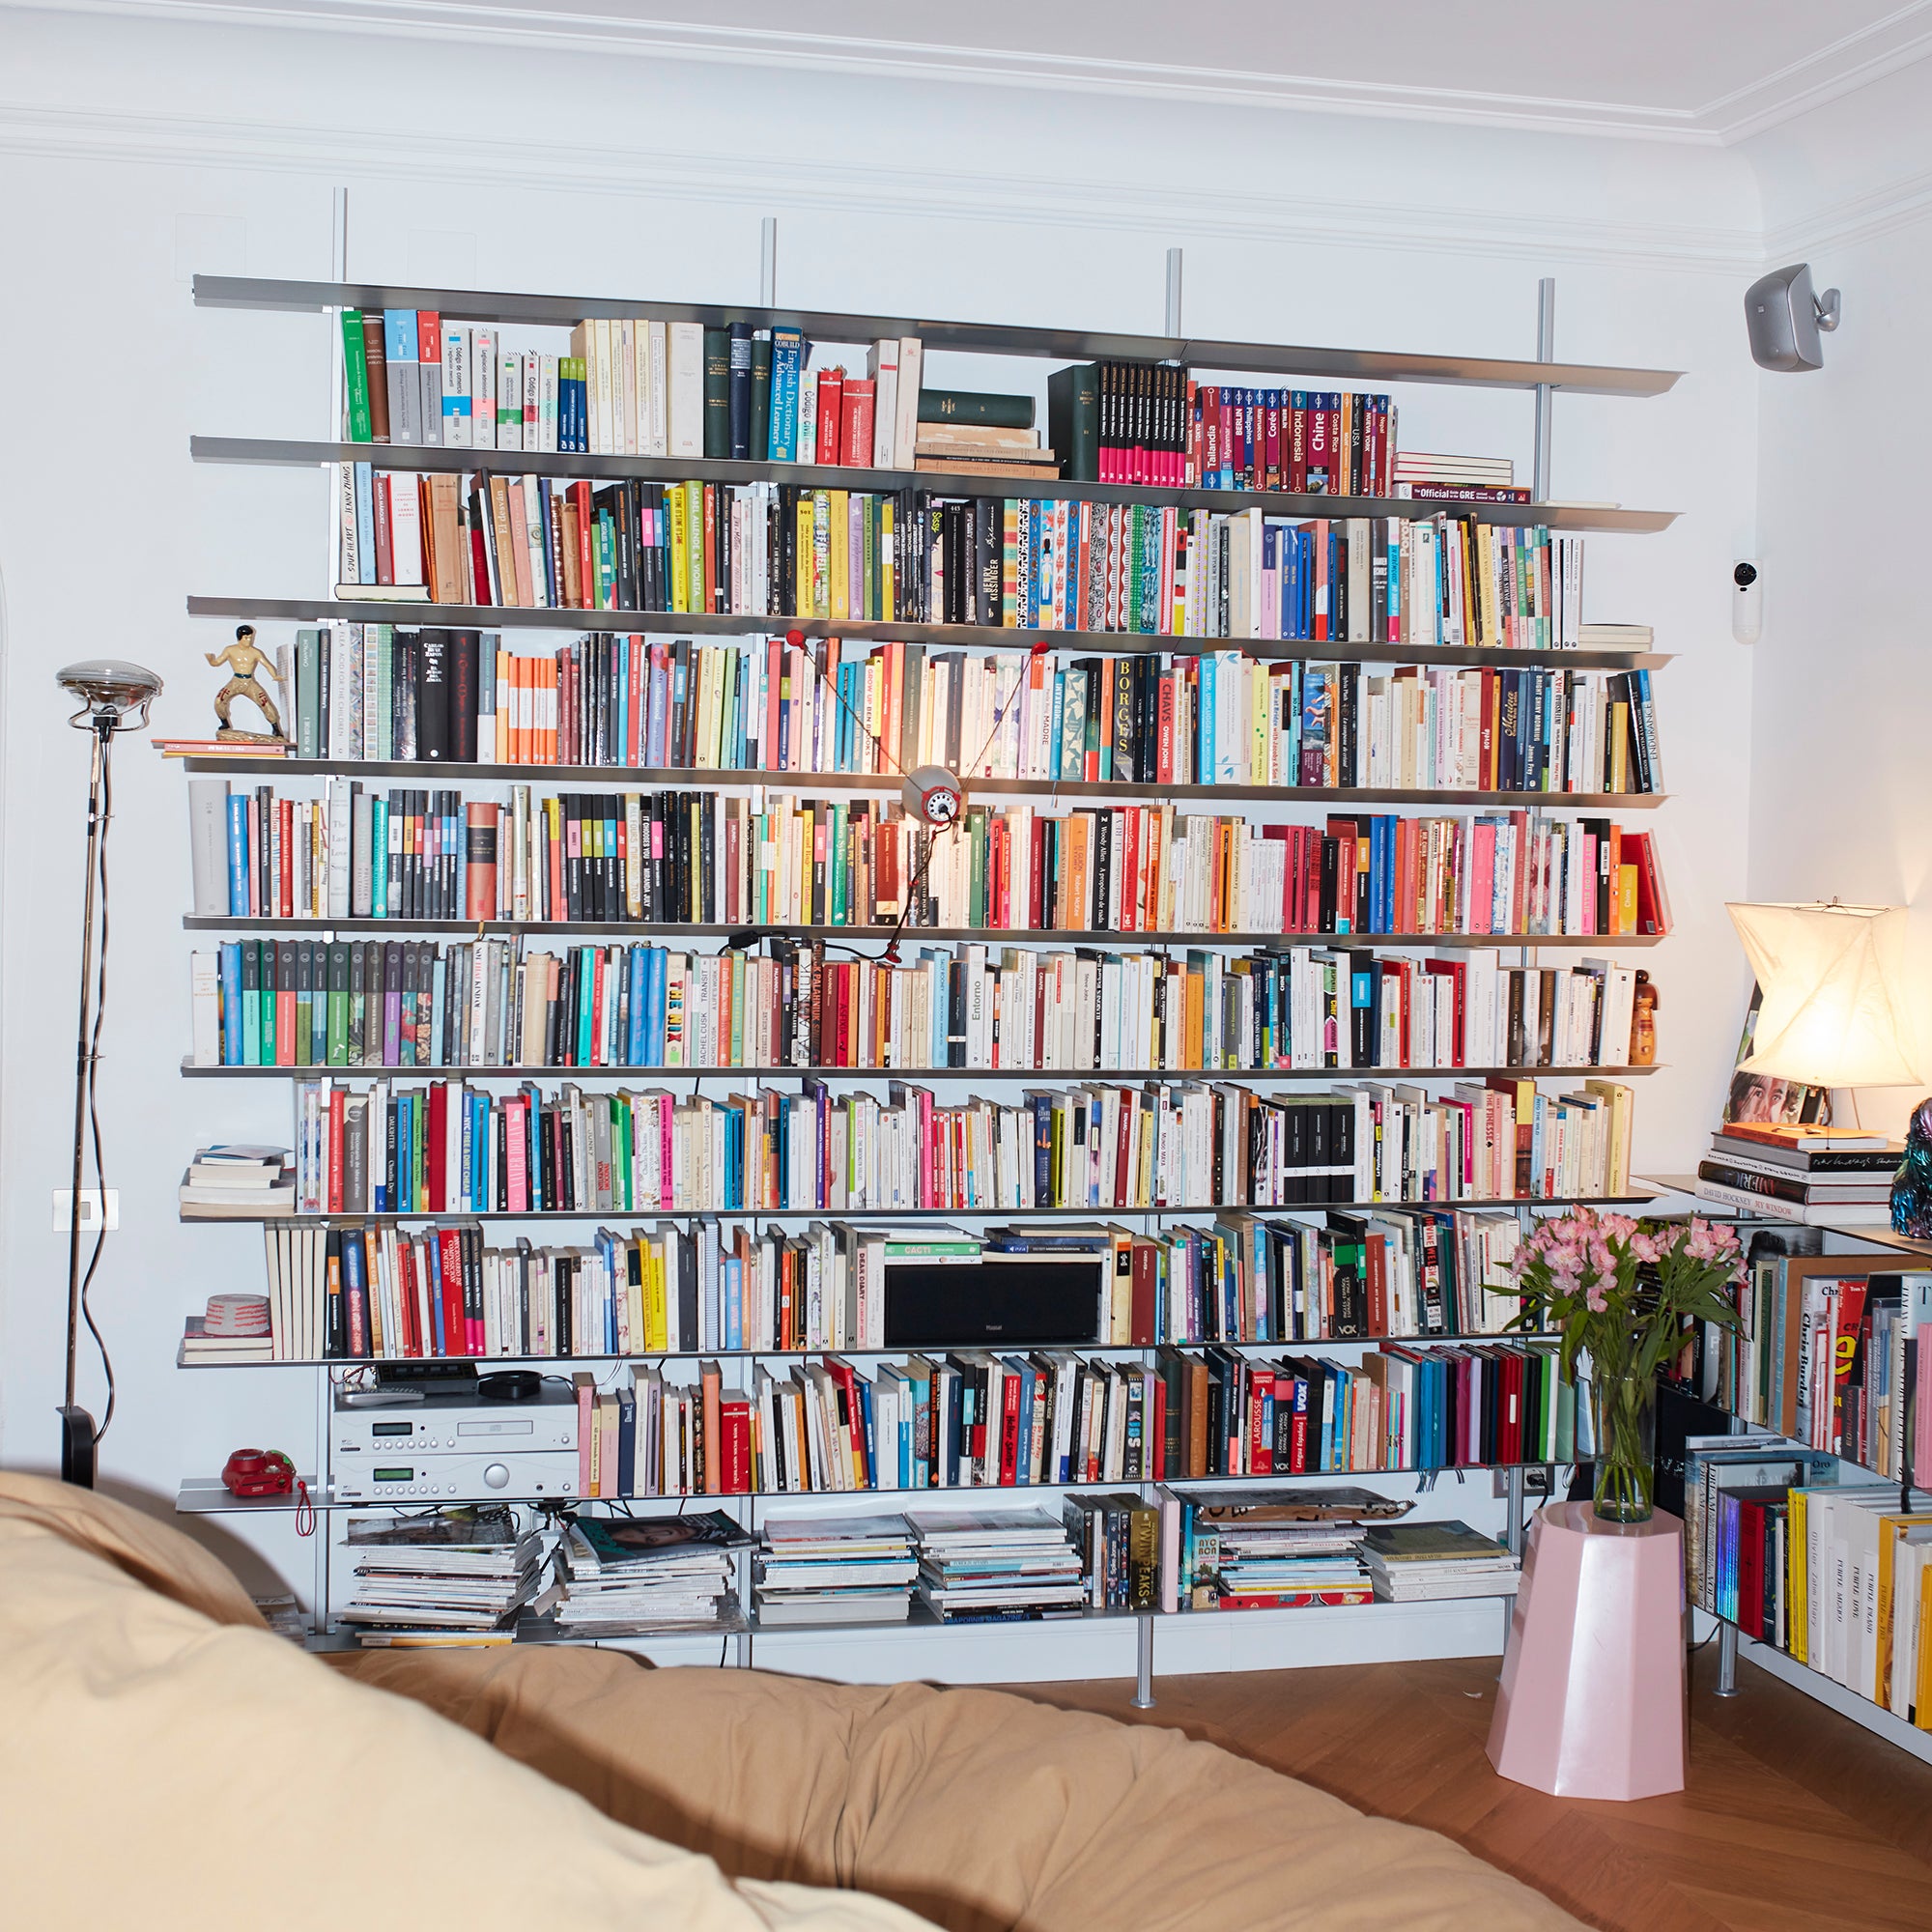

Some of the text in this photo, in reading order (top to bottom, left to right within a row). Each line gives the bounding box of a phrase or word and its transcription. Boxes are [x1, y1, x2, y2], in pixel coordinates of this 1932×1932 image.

[454, 347, 463, 364] Código
[527, 376, 536, 396] Código
[773, 349, 784, 445] for Advanced Learners
[781, 350, 797, 447] English Dictionary
[802, 390, 815, 438] Código civil
[1235, 408, 1243, 436] BERLIN
[1266, 412, 1277, 438] Corée
[1331, 412, 1340, 436] Costa
[1207, 425, 1217, 469] Tailandia
[1222, 427, 1233, 459] Myanmar
[1293, 411, 1304, 463] Indonesia
[1312, 412, 1325, 451] Chine
[1351, 428, 1361, 447] USA
[1420, 488, 1450, 498] Official
[1459, 490, 1475, 500] GRE
[342, 466, 355, 573] SOUR HEART JENNY ZHANG
[496, 490, 508, 534] El desván
[814, 495, 829, 527] MAGGIE
[930, 511, 943, 533] Sissy
[984, 505, 995, 549] Diplomacia
[692, 515, 700, 550] ALLENDE
[1399, 518, 1410, 557] Porot
[693, 563, 702, 597] VIOLETA
[982, 566, 991, 593] HENRY
[989, 558, 1000, 602] KISSINGER
[866, 668, 874, 692] GROW
[867, 694, 873, 705] UP
[1054, 683, 1064, 721] MURAKAMI
[1117, 661, 1134, 753] BORGES
[1162, 683, 1172, 723] CHAVS
[1271, 706, 1280, 726] Bridge
[1502, 690, 1515, 737] Marina
[1554, 676, 1563, 725] INTENSIDAD MAX
[864, 724, 872, 756] BROOKS
[1041, 715, 1050, 746] MADRE
[1643, 702, 1659, 761] ENDURANCE
[1161, 747, 1170, 769] JONES
[1270, 741, 1279, 760] Jacoby
[270, 806, 281, 833] Didion
[836, 809, 846, 861] Pandora Sykes
[1098, 826, 1108, 846] Woody
[1114, 817, 1123, 853] EL REY
[271, 847, 280, 869] White
[642, 894, 651, 908] JULY
[1096, 873, 1106, 900] propósito
[668, 980, 683, 1043] THE NIX
[812, 973, 822, 1021] PALAHNIUK
[972, 980, 981, 1021] Entorno
[838, 1003, 847, 1036] ASFIXIA
[699, 1035, 708, 1065] RACHEL
[387, 1115, 396, 1151] DAUGHTER
[463, 1131, 471, 1148] FREE
[1703, 1186, 1793, 1216] DAVID HOCKNEY MY WINDOW
[904, 1245, 931, 1255] CACTI
[1425, 1216, 1437, 1277] IRVINE WELSH
[1338, 1323, 1357, 1335] VOX
[1797, 1313, 1812, 1408] Chris Burden
[1296, 1382, 1307, 1412] VOX
[1005, 1415, 1016, 1439] Helter
[1253, 1399, 1263, 1444] LAROUSSE
[1295, 1421, 1305, 1468] Lengua Española
[1138, 1520, 1151, 1598] TWIN PEAKS
[1808, 1531, 1819, 1568] Olivier
[1809, 1600, 1819, 1628] Diary
